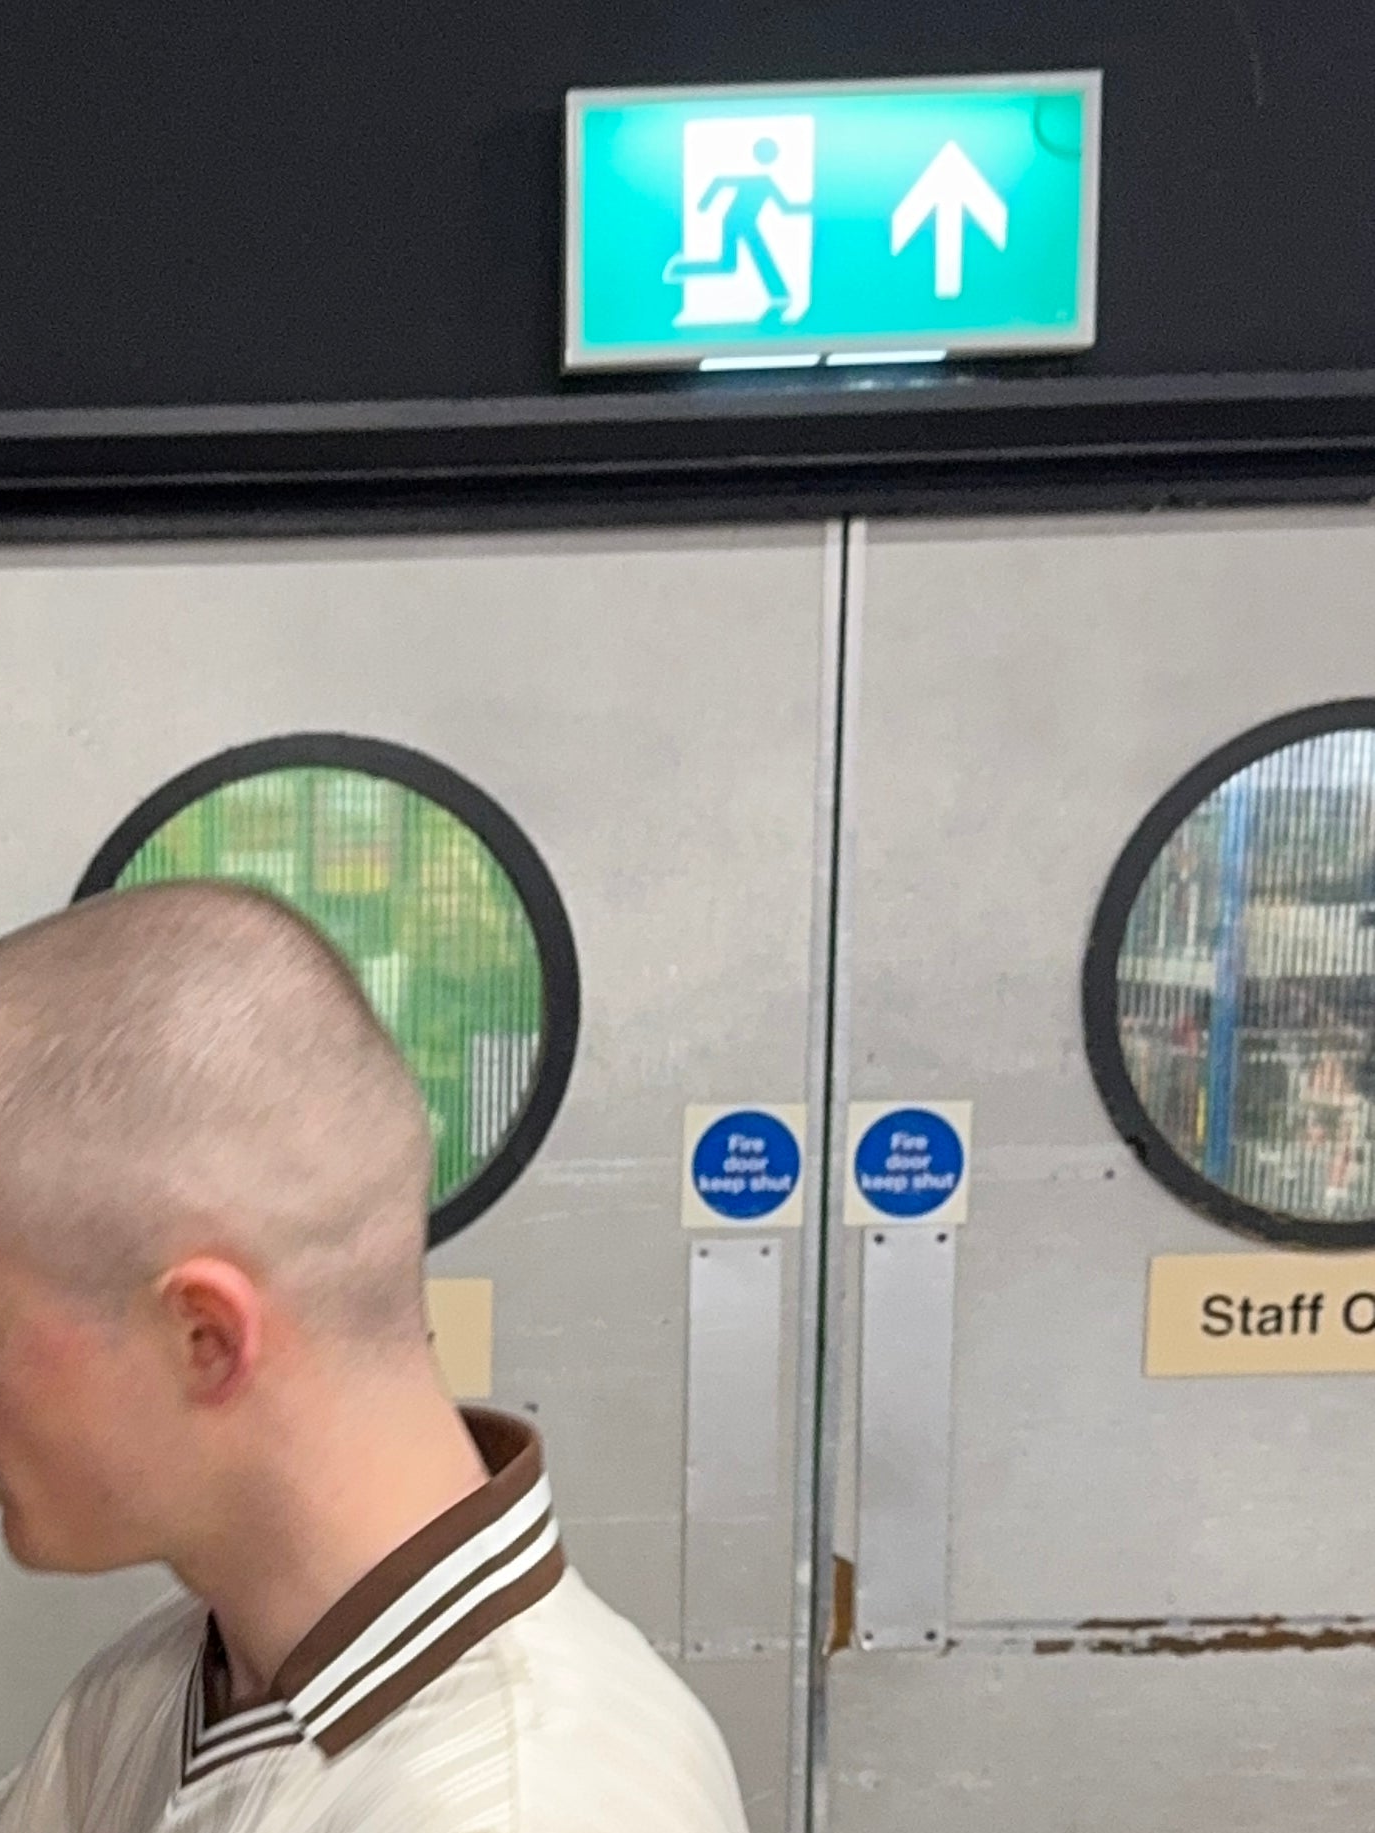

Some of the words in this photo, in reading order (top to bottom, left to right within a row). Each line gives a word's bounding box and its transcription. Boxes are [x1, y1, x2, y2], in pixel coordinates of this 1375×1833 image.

[723, 1156, 769, 1173] door
[886, 1153, 932, 1170] door
[699, 1175, 746, 1195] keep
[749, 1174, 791, 1193] shut
[861, 1173, 908, 1194] keep
[911, 1172, 955, 1191] shut
[1200, 1293, 1324, 1337] Staff
